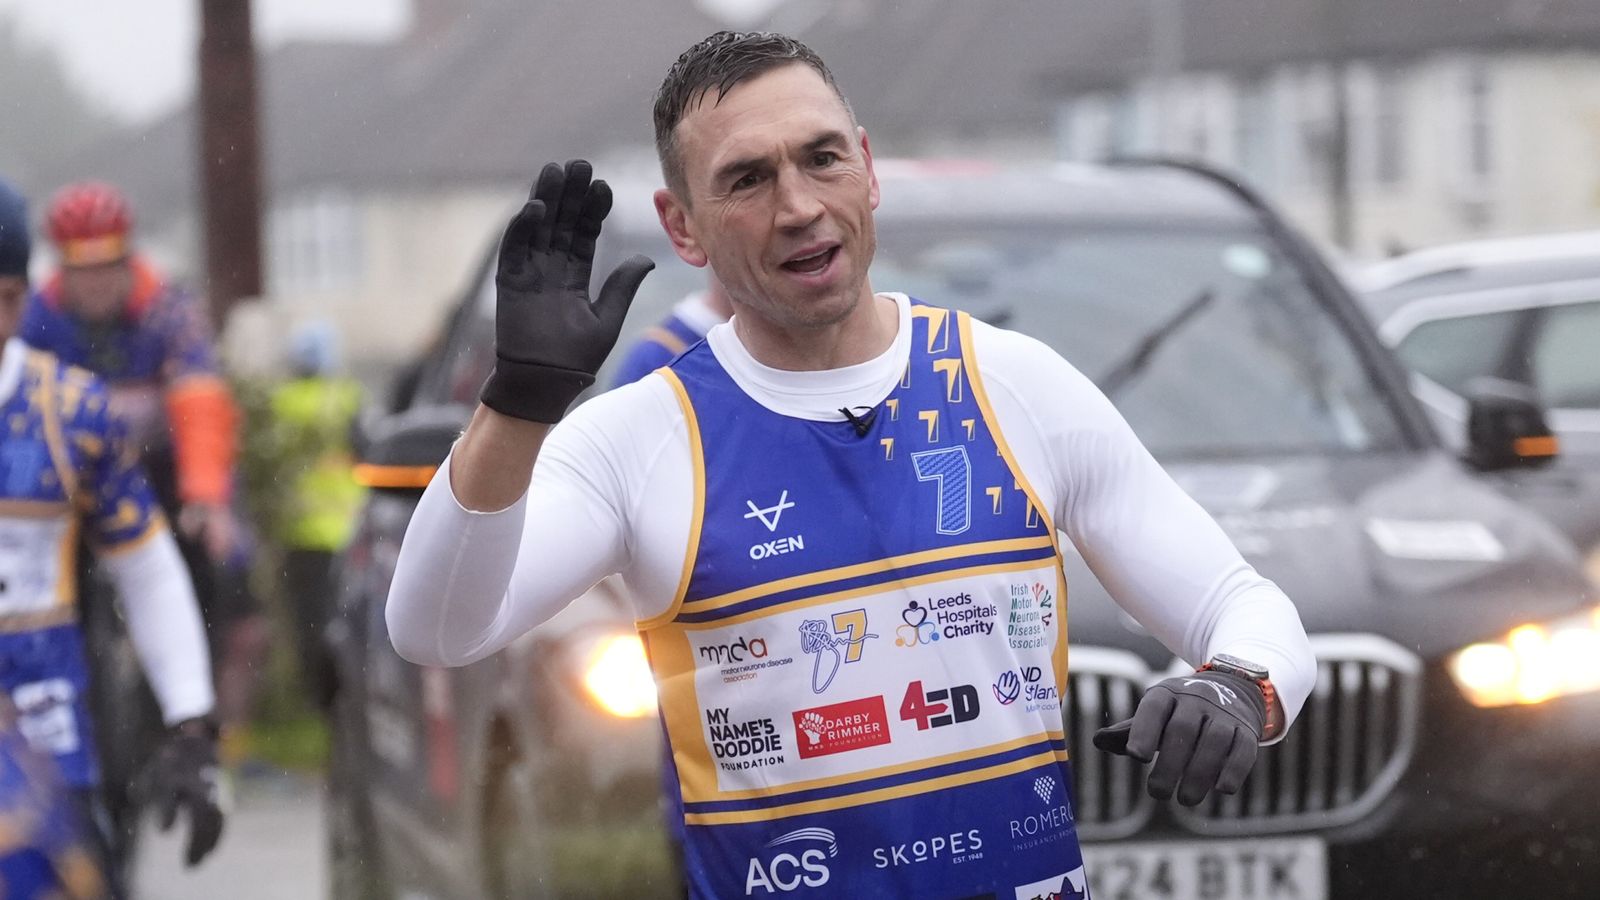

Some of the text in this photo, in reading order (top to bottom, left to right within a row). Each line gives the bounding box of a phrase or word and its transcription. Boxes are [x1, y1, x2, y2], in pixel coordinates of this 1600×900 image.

[911, 445, 971, 535] 7
[749, 534, 805, 560] OXEN
[1010, 583, 1029, 597] Irish
[928, 592, 972, 611] Leeds
[1011, 598, 1032, 610] Motor
[937, 604, 997, 625] Hospitals
[943, 620, 994, 639] Charity
[699, 636, 768, 665] mnda
[766, 657, 793, 668] disease
[899, 680, 981, 731] 4ED
[706, 707, 730, 725] MY
[825, 712, 870, 730] DARBY
[827, 722, 881, 740] RIMMER
[712, 734, 783, 759] DODDIE
[720, 755, 785, 771] FOUNDATION
[873, 829, 983, 868] SKOPES
[745, 848, 830, 896] ACS
[1198, 853, 1299, 900] BTK
